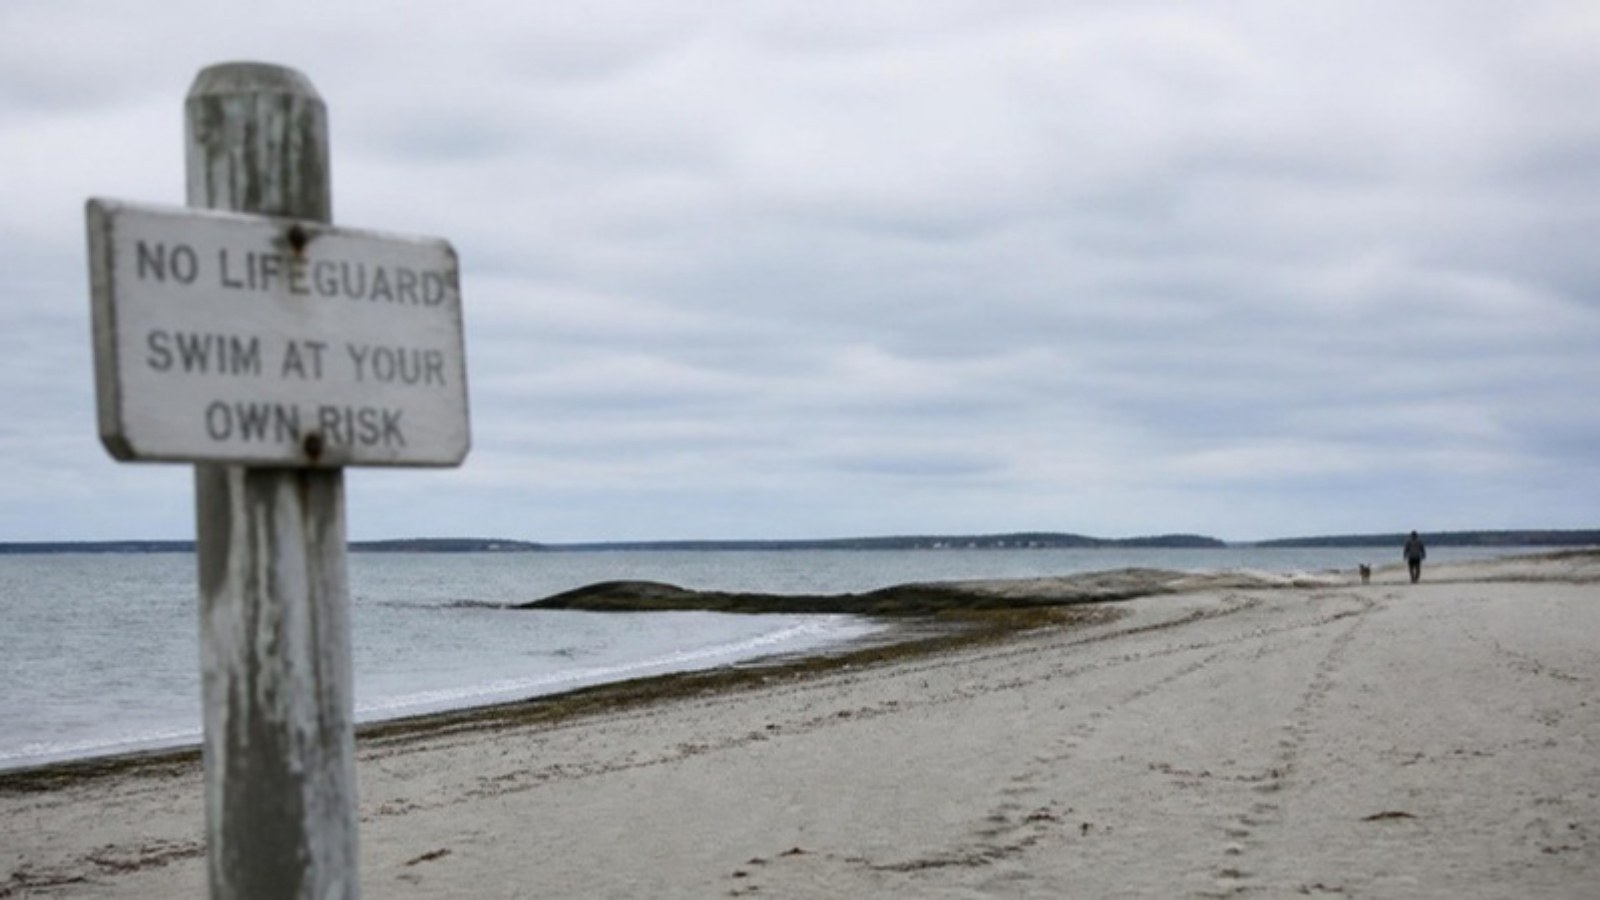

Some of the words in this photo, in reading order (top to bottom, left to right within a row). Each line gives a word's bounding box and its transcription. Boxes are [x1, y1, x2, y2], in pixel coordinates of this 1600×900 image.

[136, 241, 197, 285] NO
[219, 249, 445, 306] LIFEGUARD
[147, 331, 261, 376] SWIM
[281, 341, 328, 380] AT
[347, 344, 446, 386] YOUR
[205, 401, 298, 443] OWN
[318, 405, 407, 447] RISK
